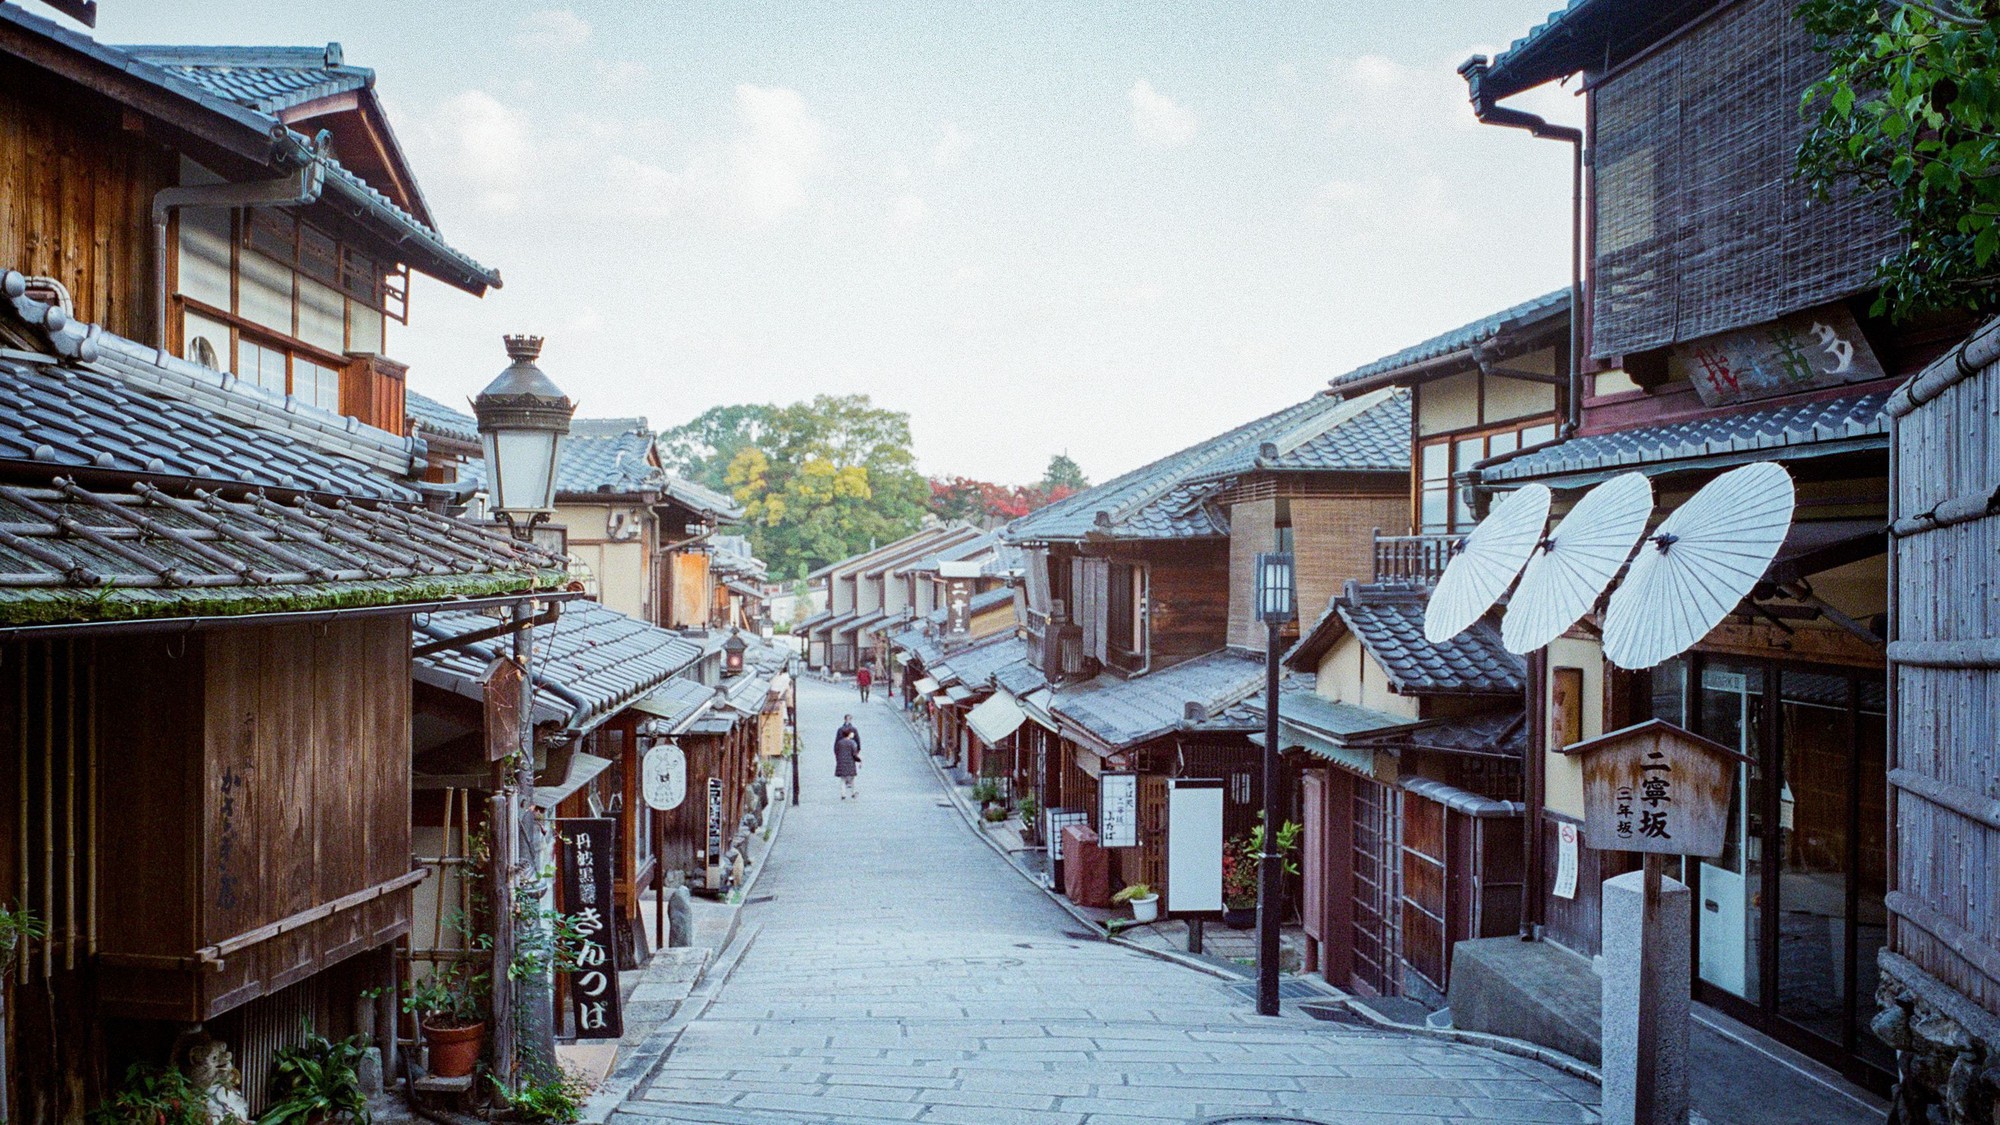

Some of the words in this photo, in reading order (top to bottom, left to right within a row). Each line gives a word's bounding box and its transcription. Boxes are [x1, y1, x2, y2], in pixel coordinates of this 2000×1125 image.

[1639, 751, 1671, 839] 二寧坂
[1104, 810, 1116, 840] ふたば
